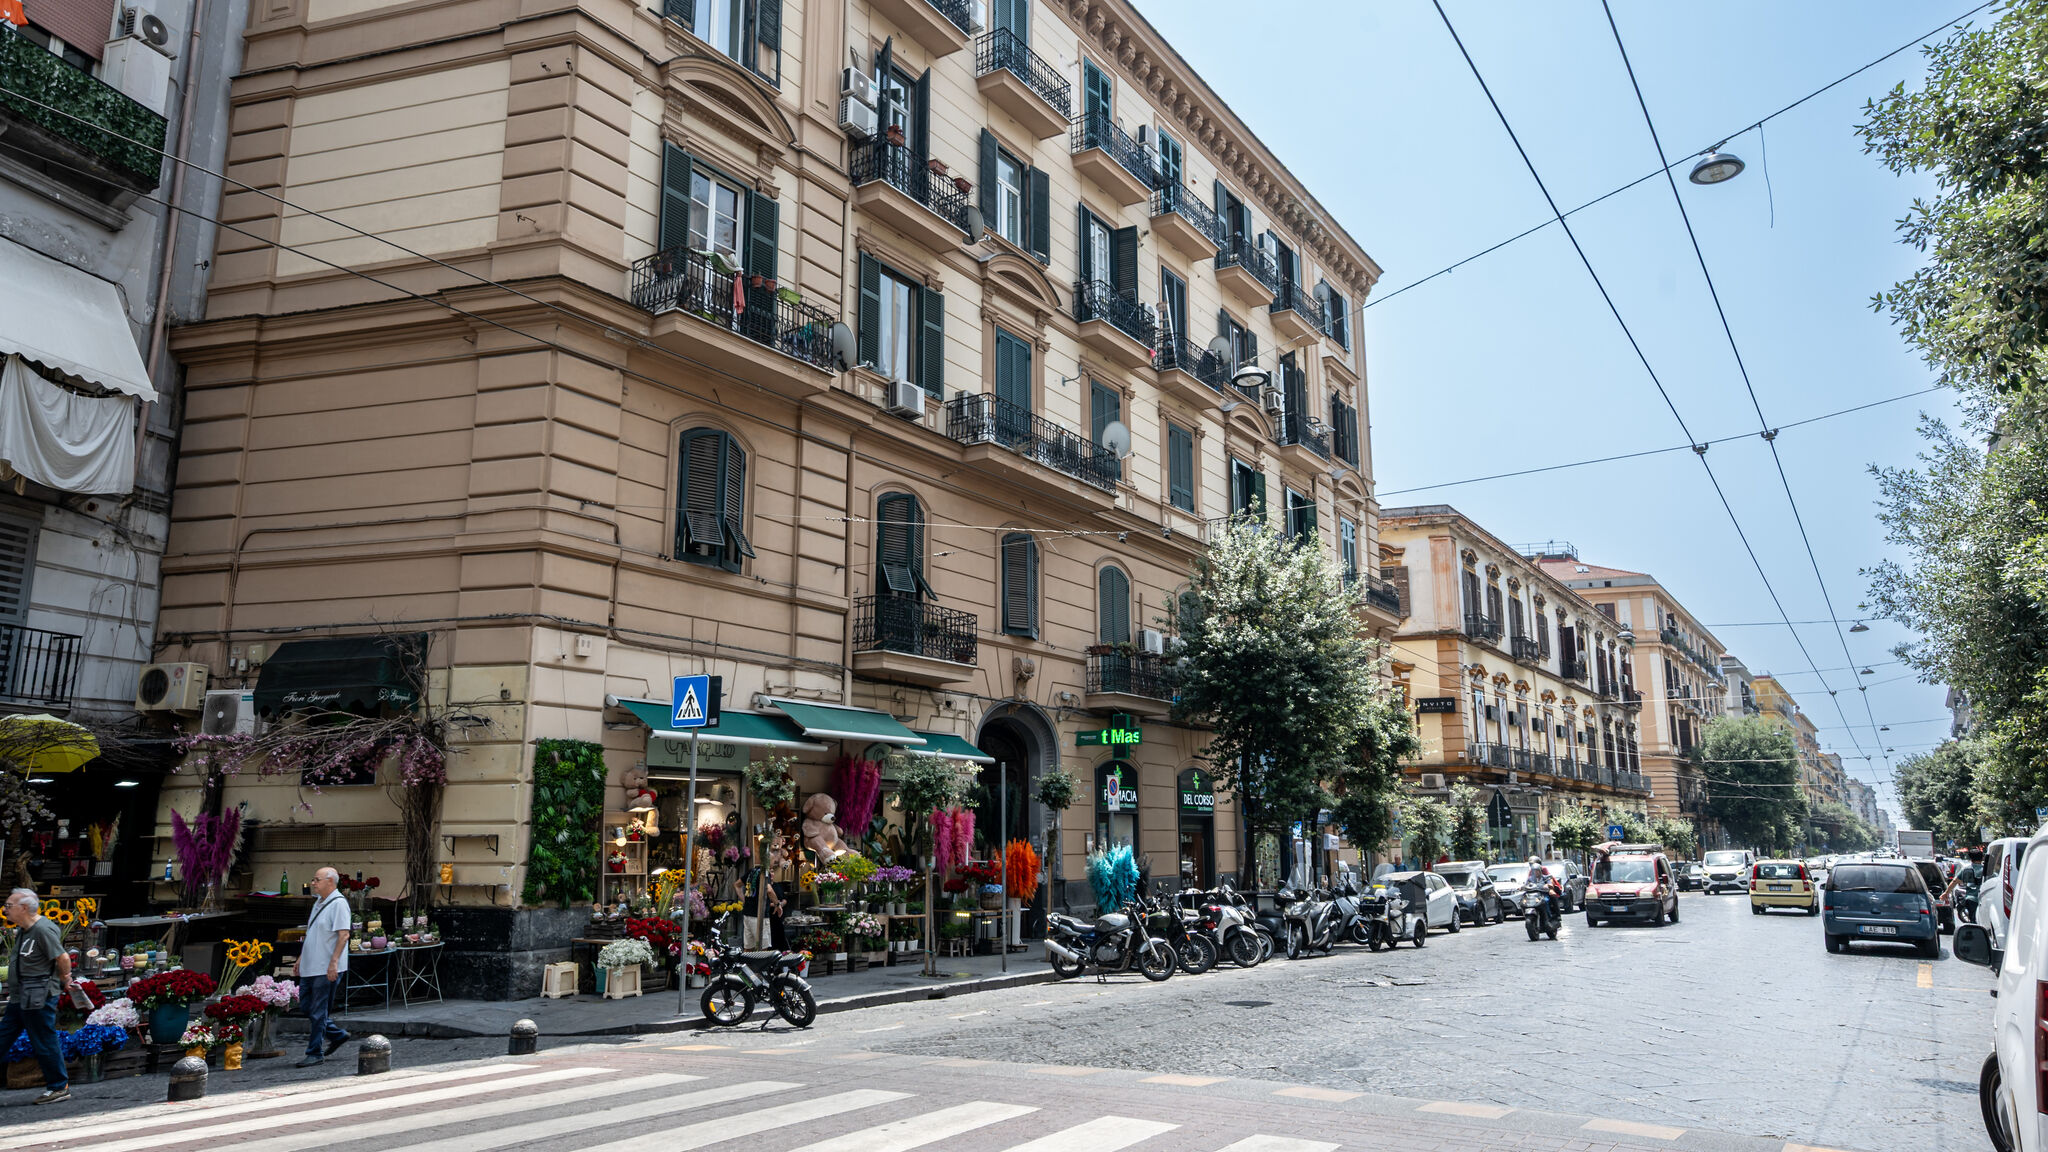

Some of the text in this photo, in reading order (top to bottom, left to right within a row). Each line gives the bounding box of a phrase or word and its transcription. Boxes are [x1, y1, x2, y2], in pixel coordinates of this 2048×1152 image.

[1103, 789, 1137, 802] FACIA
[1183, 793, 1214, 806] DEL CORSO
